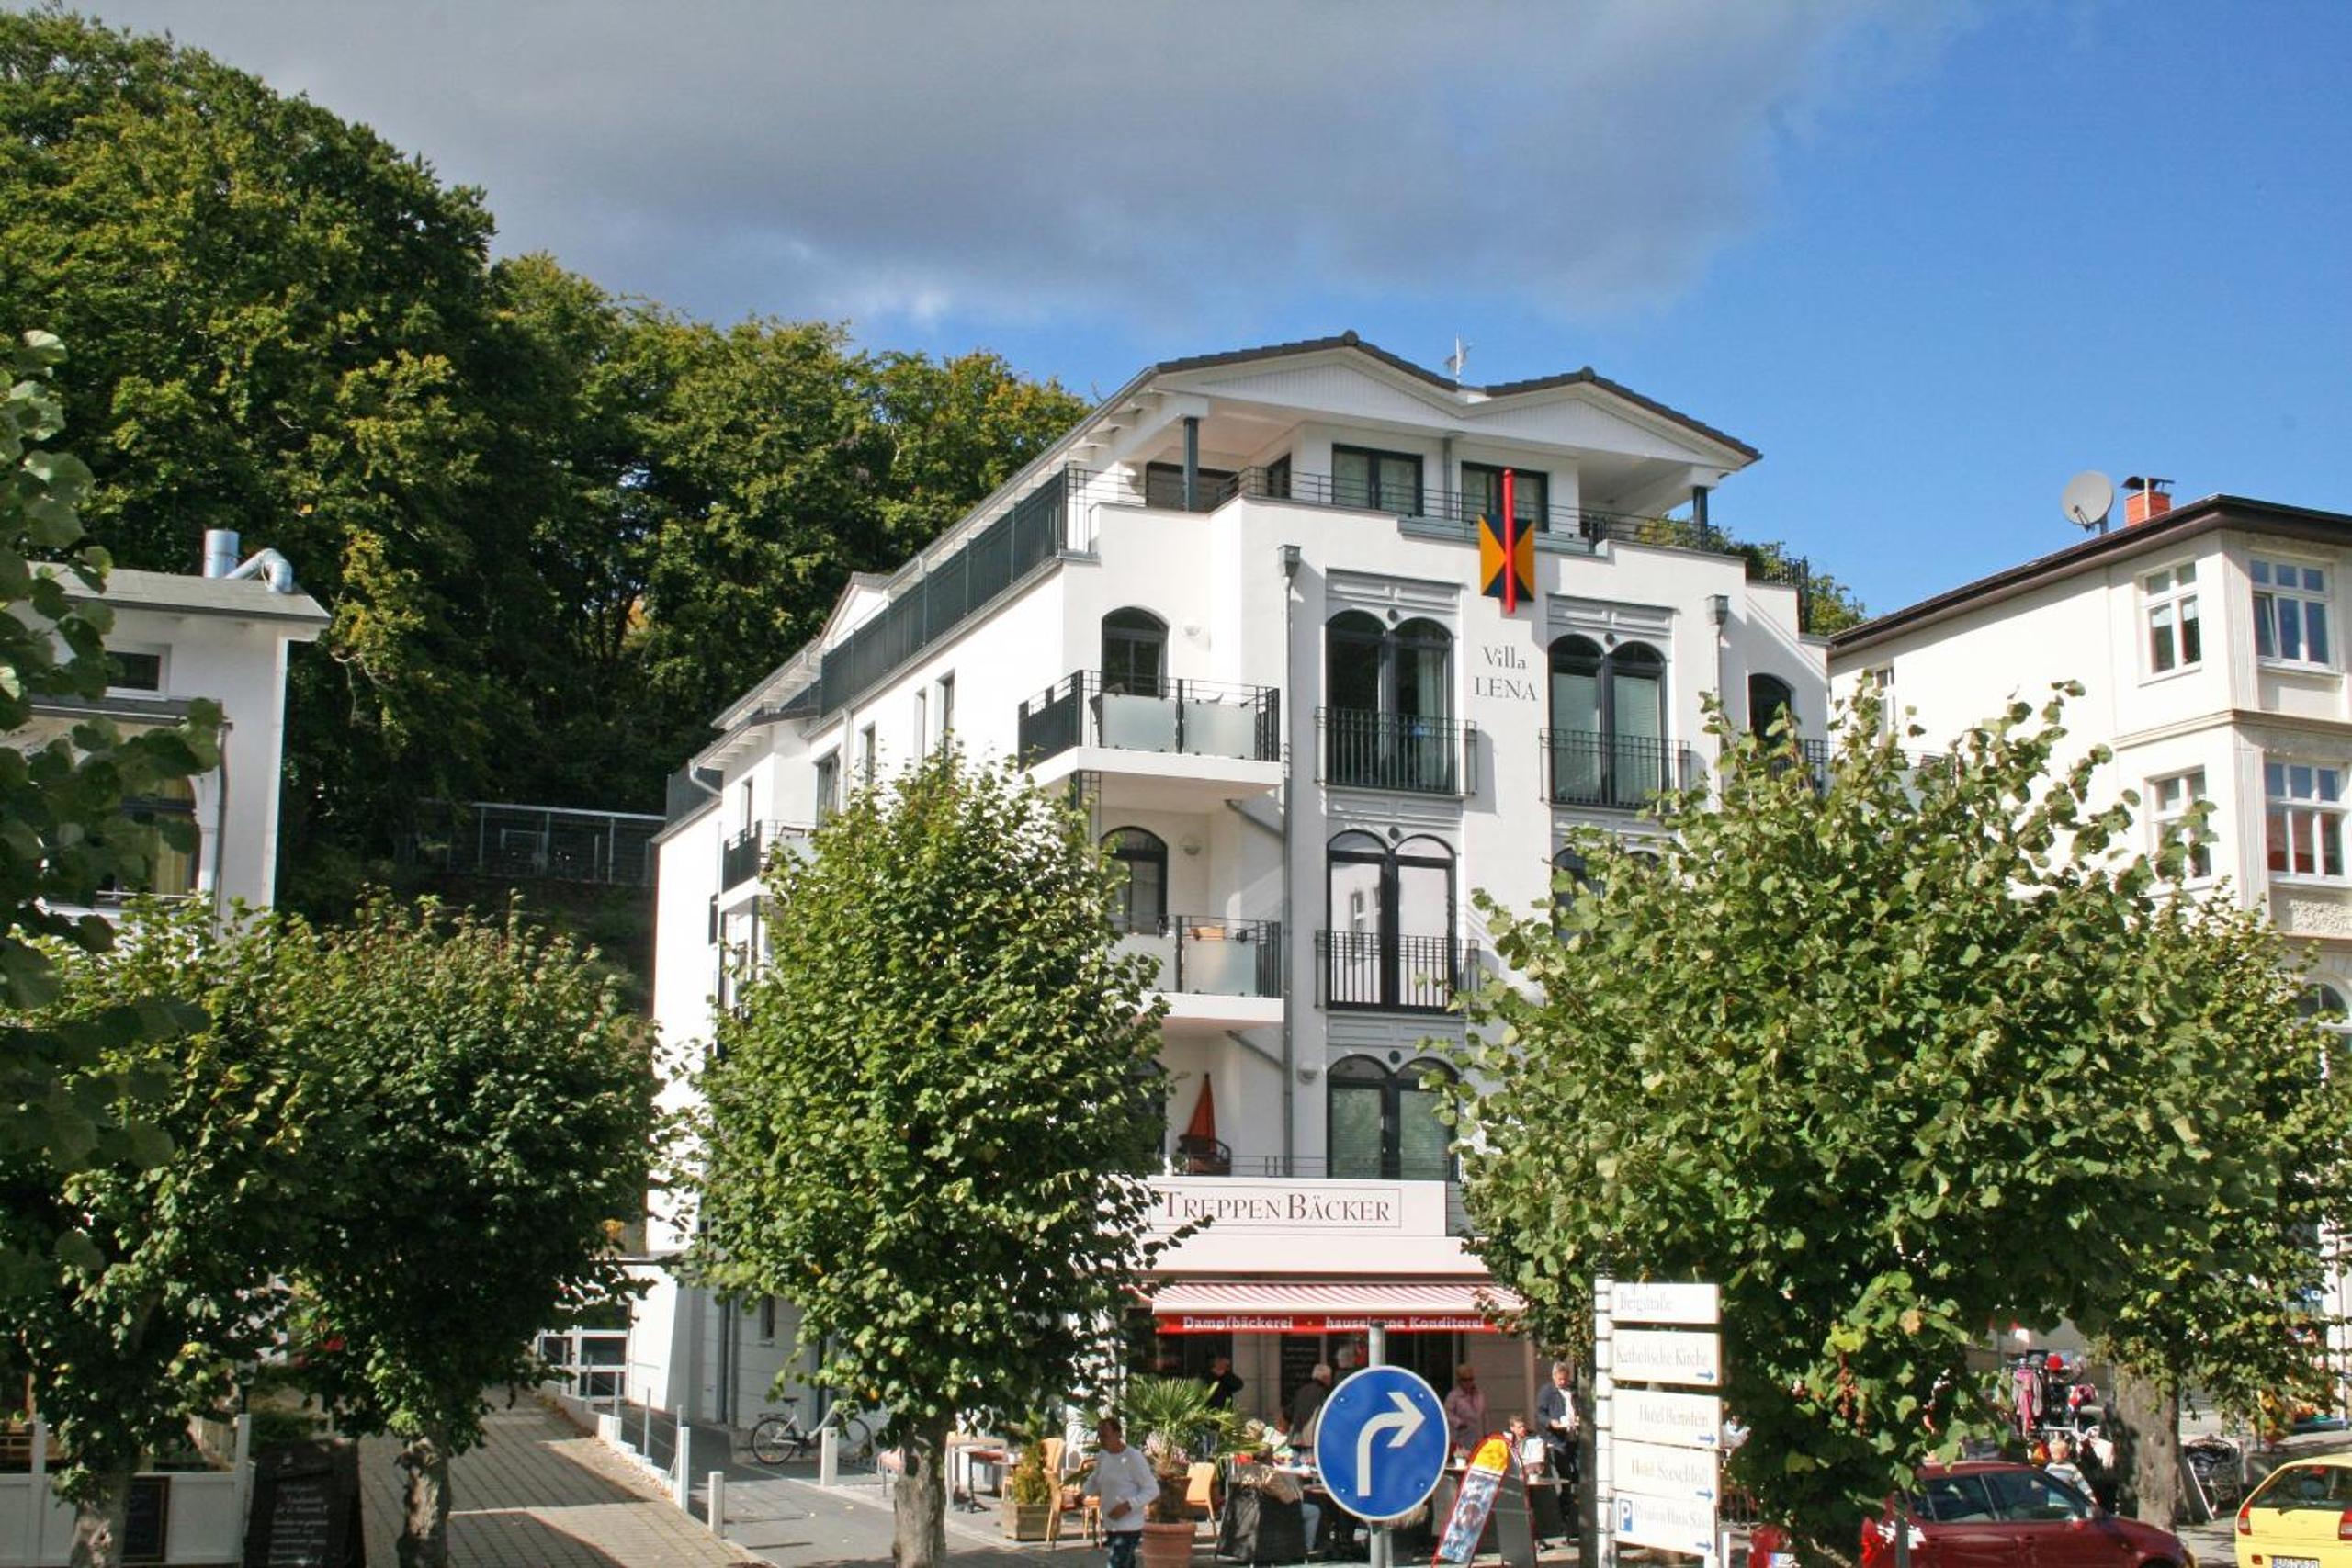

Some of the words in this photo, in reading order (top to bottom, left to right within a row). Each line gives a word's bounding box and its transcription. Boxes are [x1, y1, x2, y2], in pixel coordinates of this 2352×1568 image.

[1483, 646, 1526, 669] Villa
[1473, 677, 1536, 701] LENA
[1182, 1316, 1294, 1329] Dampfbäckerei
[1326, 1316, 1406, 1329] hauseine
[1409, 1316, 1485, 1329] Konditorei
